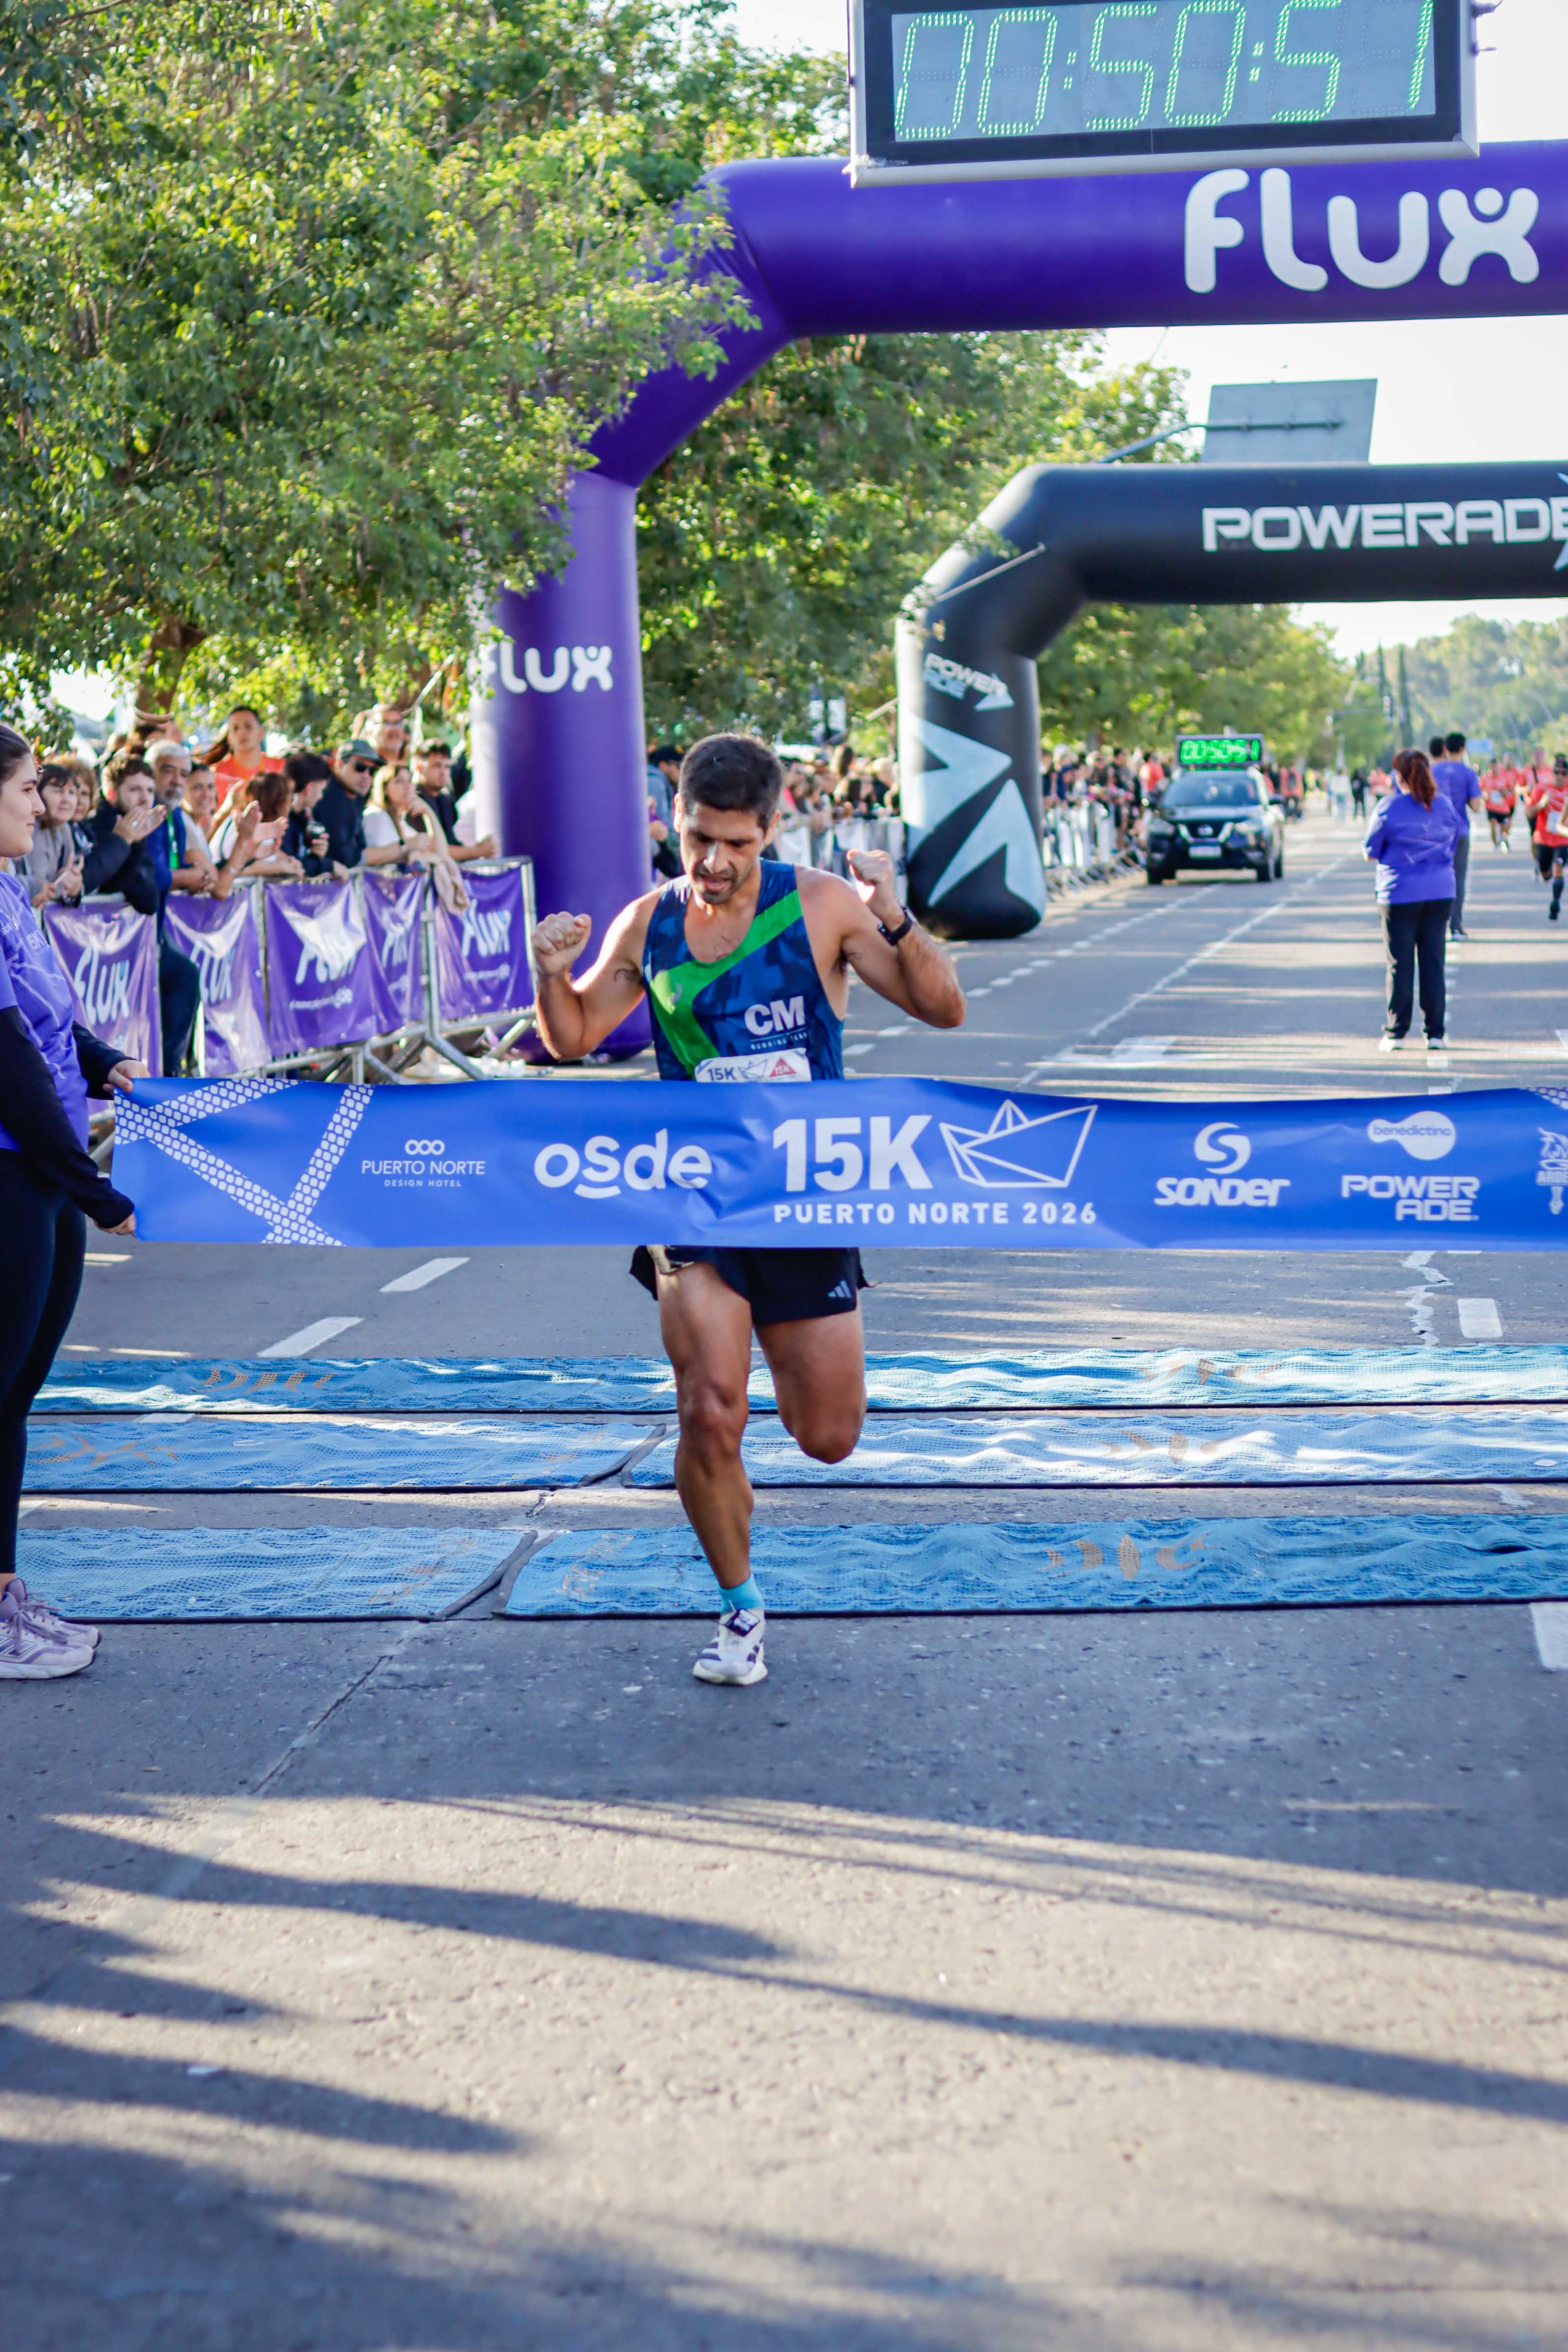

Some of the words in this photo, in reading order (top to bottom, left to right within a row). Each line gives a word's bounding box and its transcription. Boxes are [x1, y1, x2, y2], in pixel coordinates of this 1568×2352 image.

[894, 0, 1435, 139] 00:50:51
[744, 995, 806, 1036] CM
[708, 1067, 736, 1081] 15K
[362, 1160, 425, 1175] PUERTO
[430, 1160, 486, 1175] NORTE
[534, 1128, 713, 1190] osde
[773, 1115, 933, 1191] 15K
[1341, 1175, 1480, 1199] POWER
[774, 1204, 895, 1224] PUERTO
[908, 1203, 1009, 1224] NORTE
[1022, 1202, 1097, 1224] 2026
